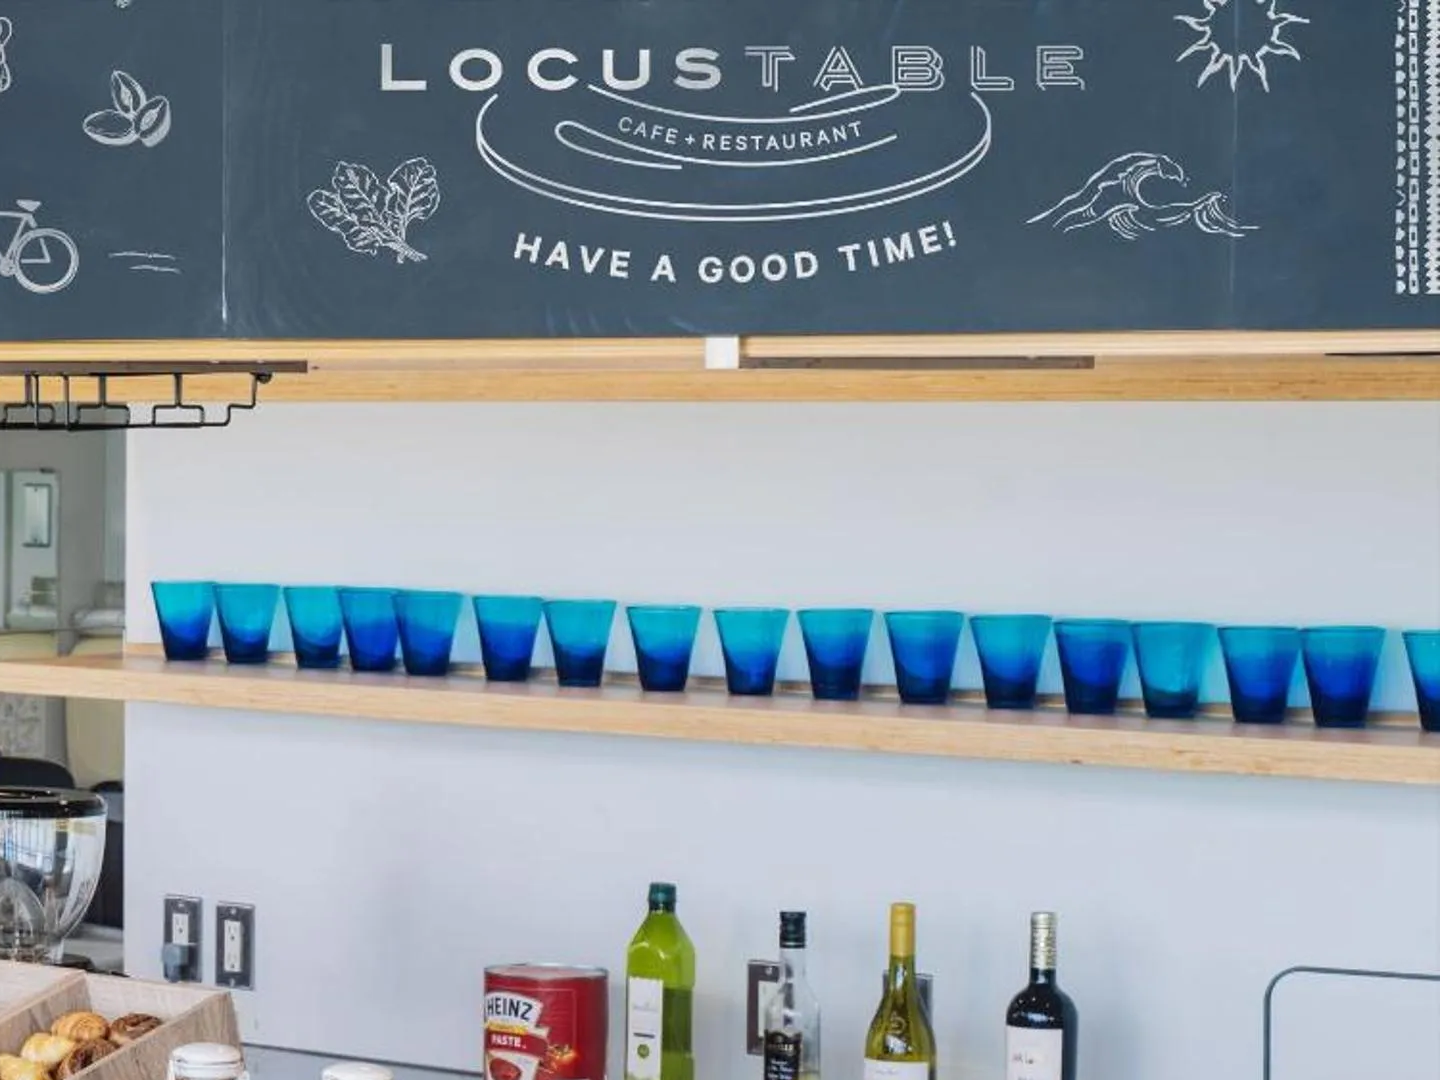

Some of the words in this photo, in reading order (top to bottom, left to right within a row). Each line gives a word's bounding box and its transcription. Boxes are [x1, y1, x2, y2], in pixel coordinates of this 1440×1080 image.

[618, 116, 679, 145] CAFE
[702, 120, 863, 152] RESTAURANT
[513, 232, 631, 279] HAVE
[650, 254, 677, 283] A
[697, 251, 819, 284] GOOD
[837, 220, 957, 273] TIME!
[487, 998, 533, 1020] HEINZ
